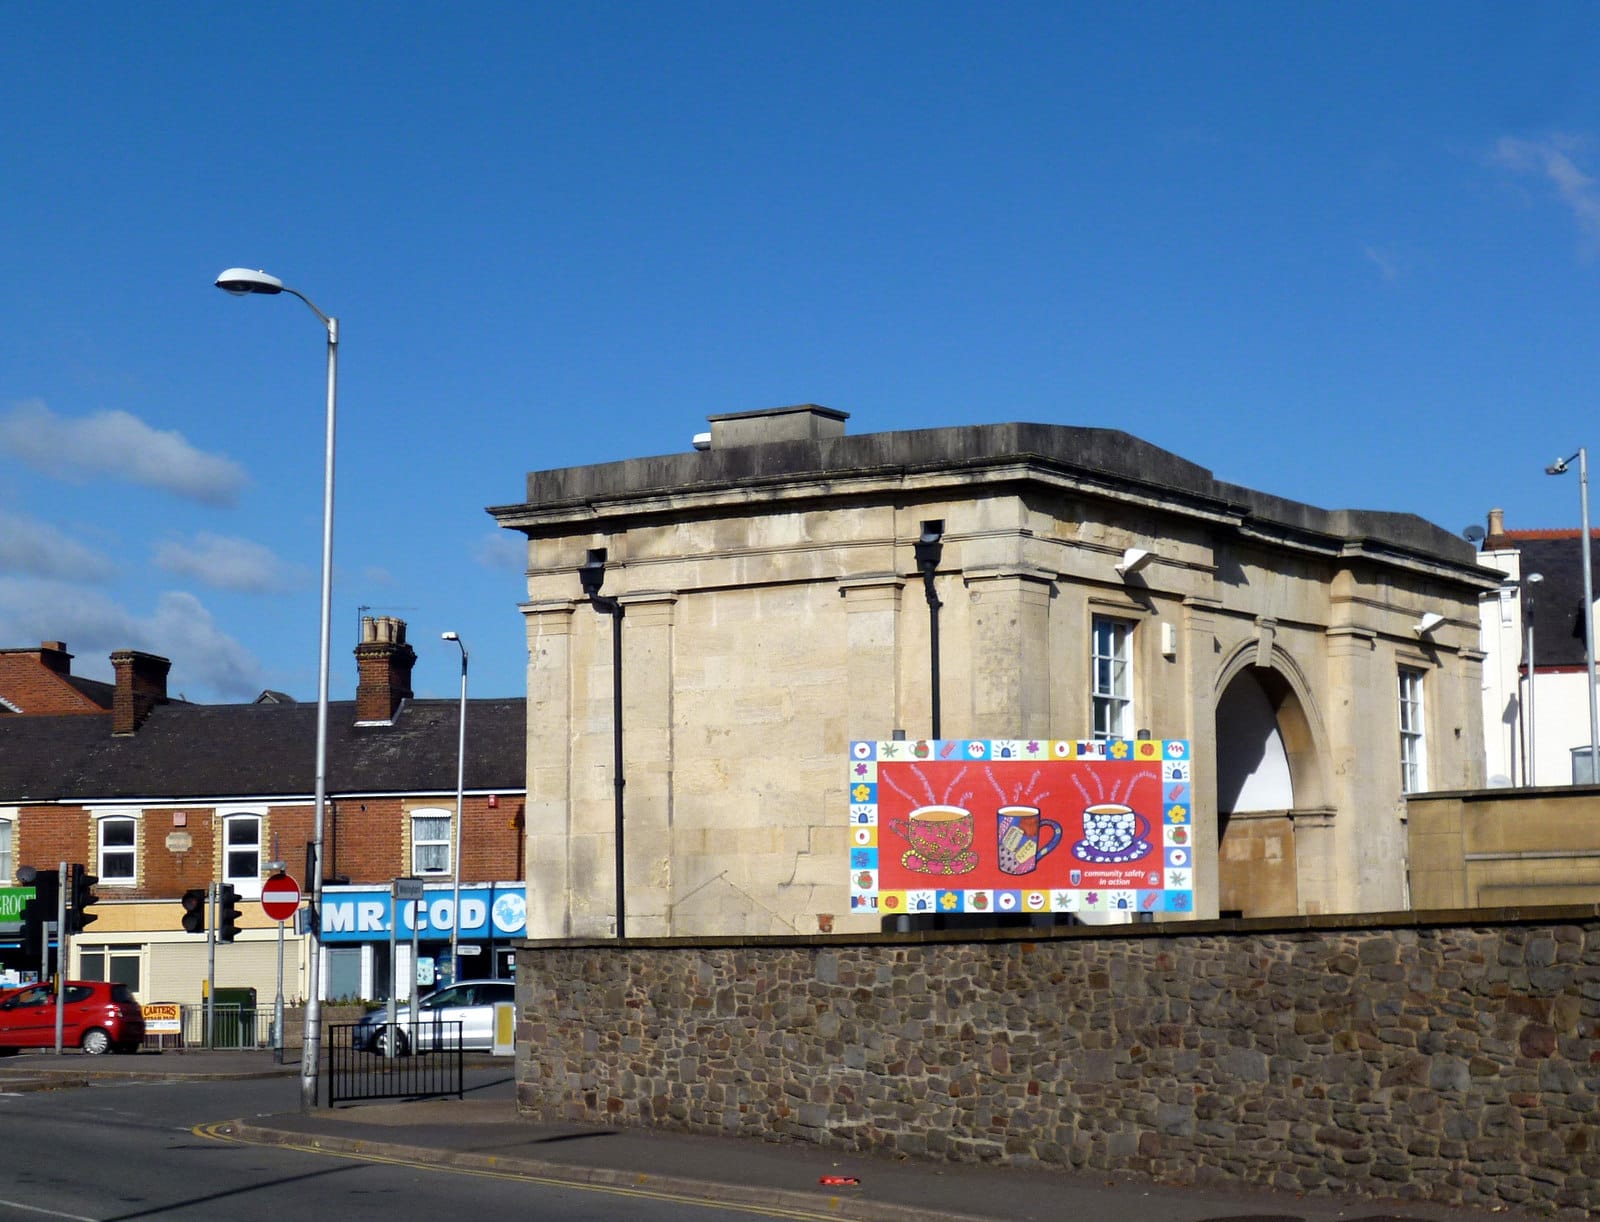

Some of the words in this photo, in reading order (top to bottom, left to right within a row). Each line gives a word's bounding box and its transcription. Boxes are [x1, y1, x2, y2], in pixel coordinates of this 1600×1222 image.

[1084, 870, 1122, 879] community
[1125, 870, 1146, 879] safety
[403, 899, 487, 931] COD
[143, 1005, 177, 1017] CARTERS
